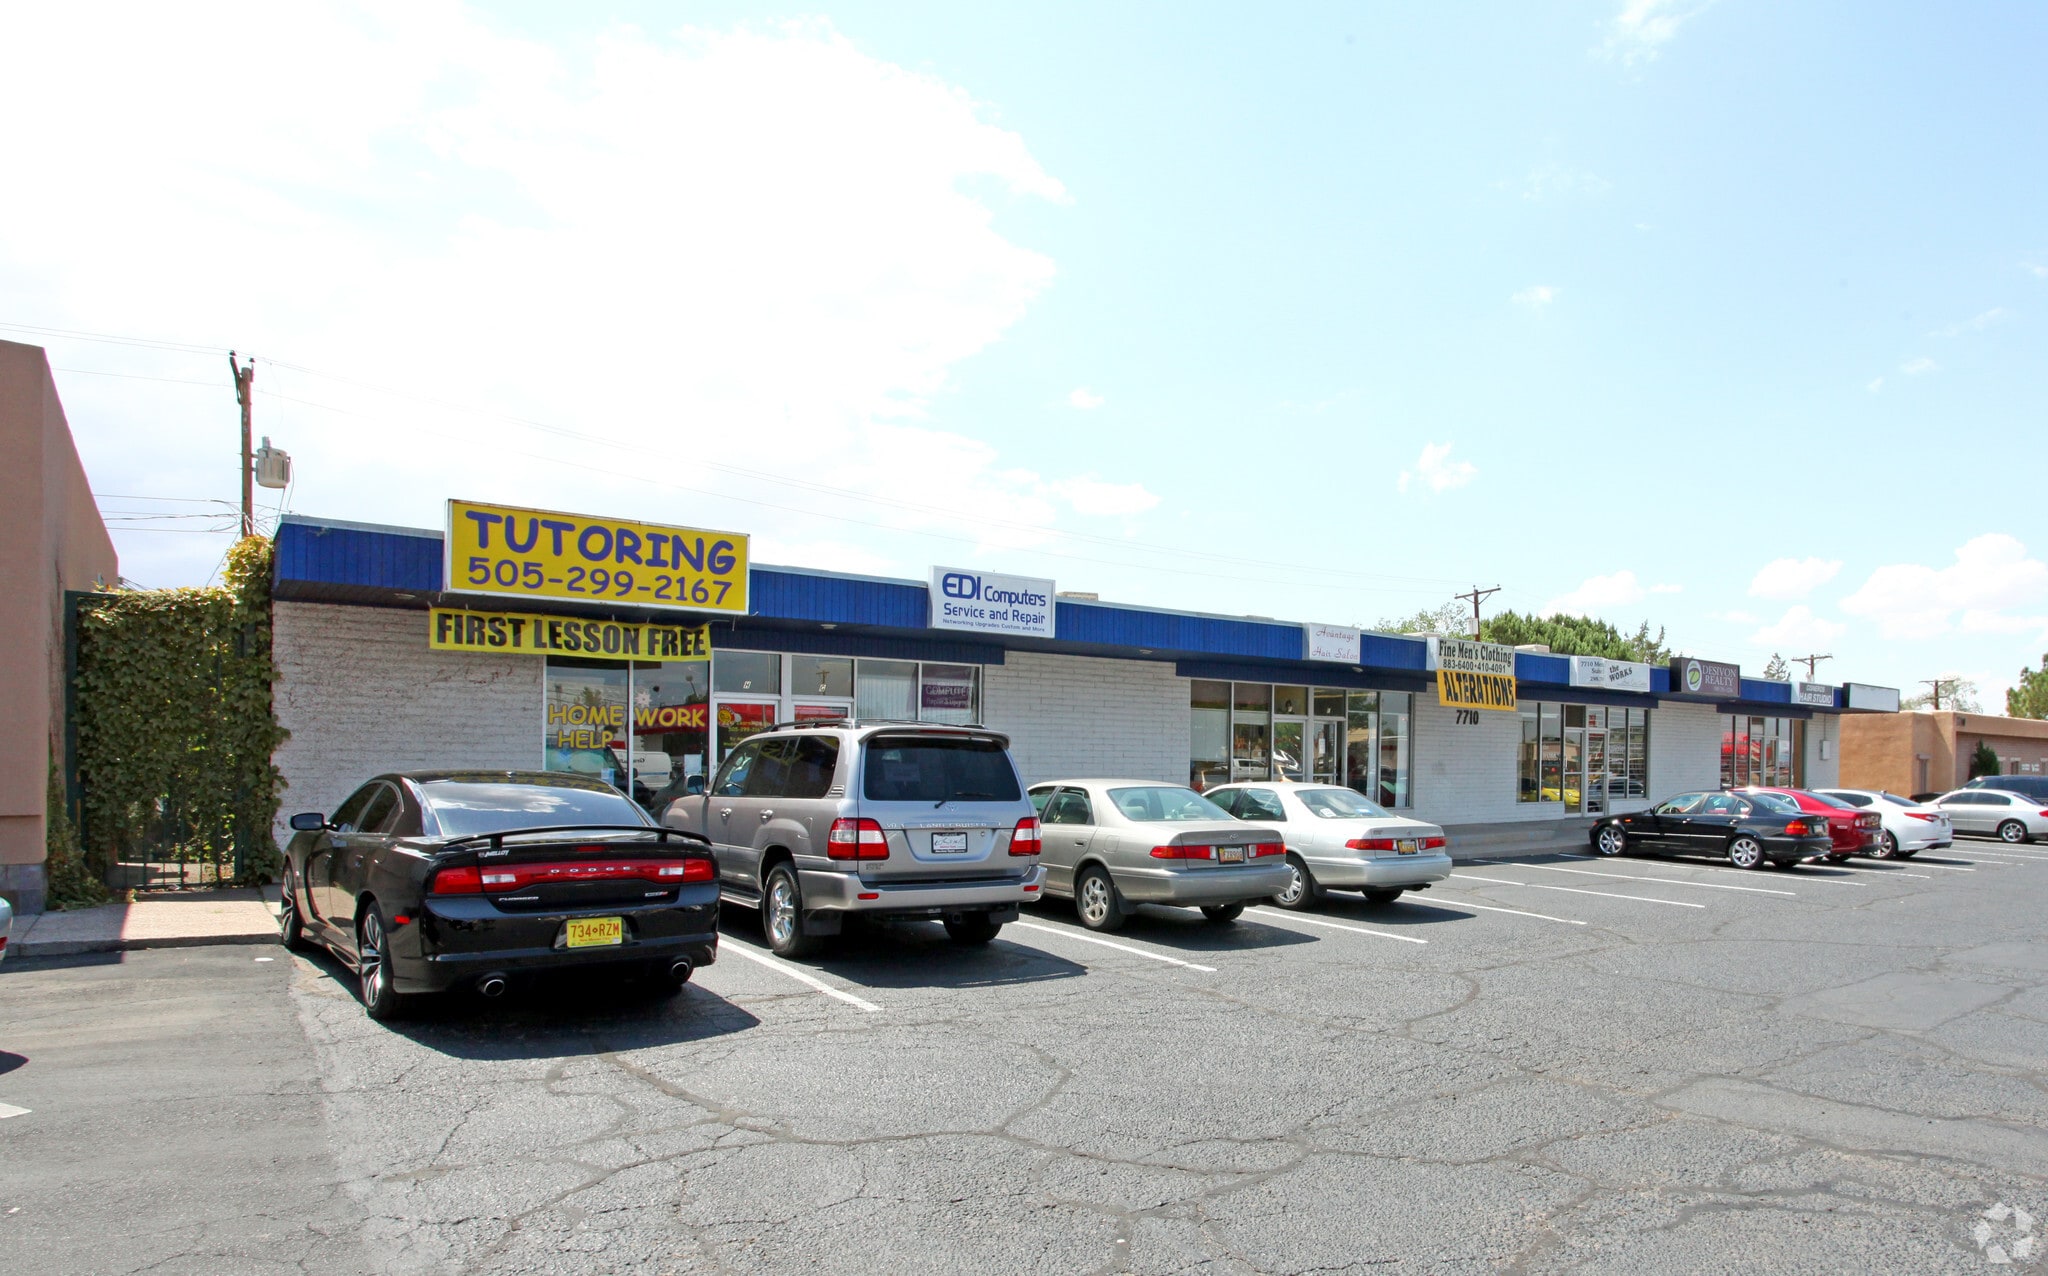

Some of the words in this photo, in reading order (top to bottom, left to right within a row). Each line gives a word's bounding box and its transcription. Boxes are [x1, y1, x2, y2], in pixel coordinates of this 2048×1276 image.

[465, 510, 736, 575] TUTORING
[468, 556, 732, 605] 505-299-2167
[942, 572, 981, 600] EDI
[984, 585, 1046, 607] Computers
[942, 618, 974, 627] Networking
[943, 602, 984, 617] Service
[989, 609, 1008, 621] and
[1012, 609, 1046, 626] Repair
[437, 613, 526, 647] FIRST
[534, 619, 640, 655] LESSON
[647, 626, 706, 657] FREE
[1311, 646, 1331, 657] Hair
[1334, 647, 1358, 660] Salon
[1438, 640, 1456, 657] Fine
[1457, 642, 1479, 660] Men's
[1480, 645, 1512, 667] Clothing
[1608, 666, 1633, 682] WORKS
[1609, 664, 1620, 674] the
[1702, 664, 1736, 678] DESIVON
[1443, 671, 1515, 707] ALTERATIONS
[1705, 674, 1734, 687] REALTY
[1800, 692, 1812, 702] HAIR
[1812, 693, 1832, 704] STUDIO
[548, 704, 625, 726] HOME
[634, 707, 706, 728] WORK
[1456, 709, 1480, 725] 7710
[557, 729, 614, 749] HELP
